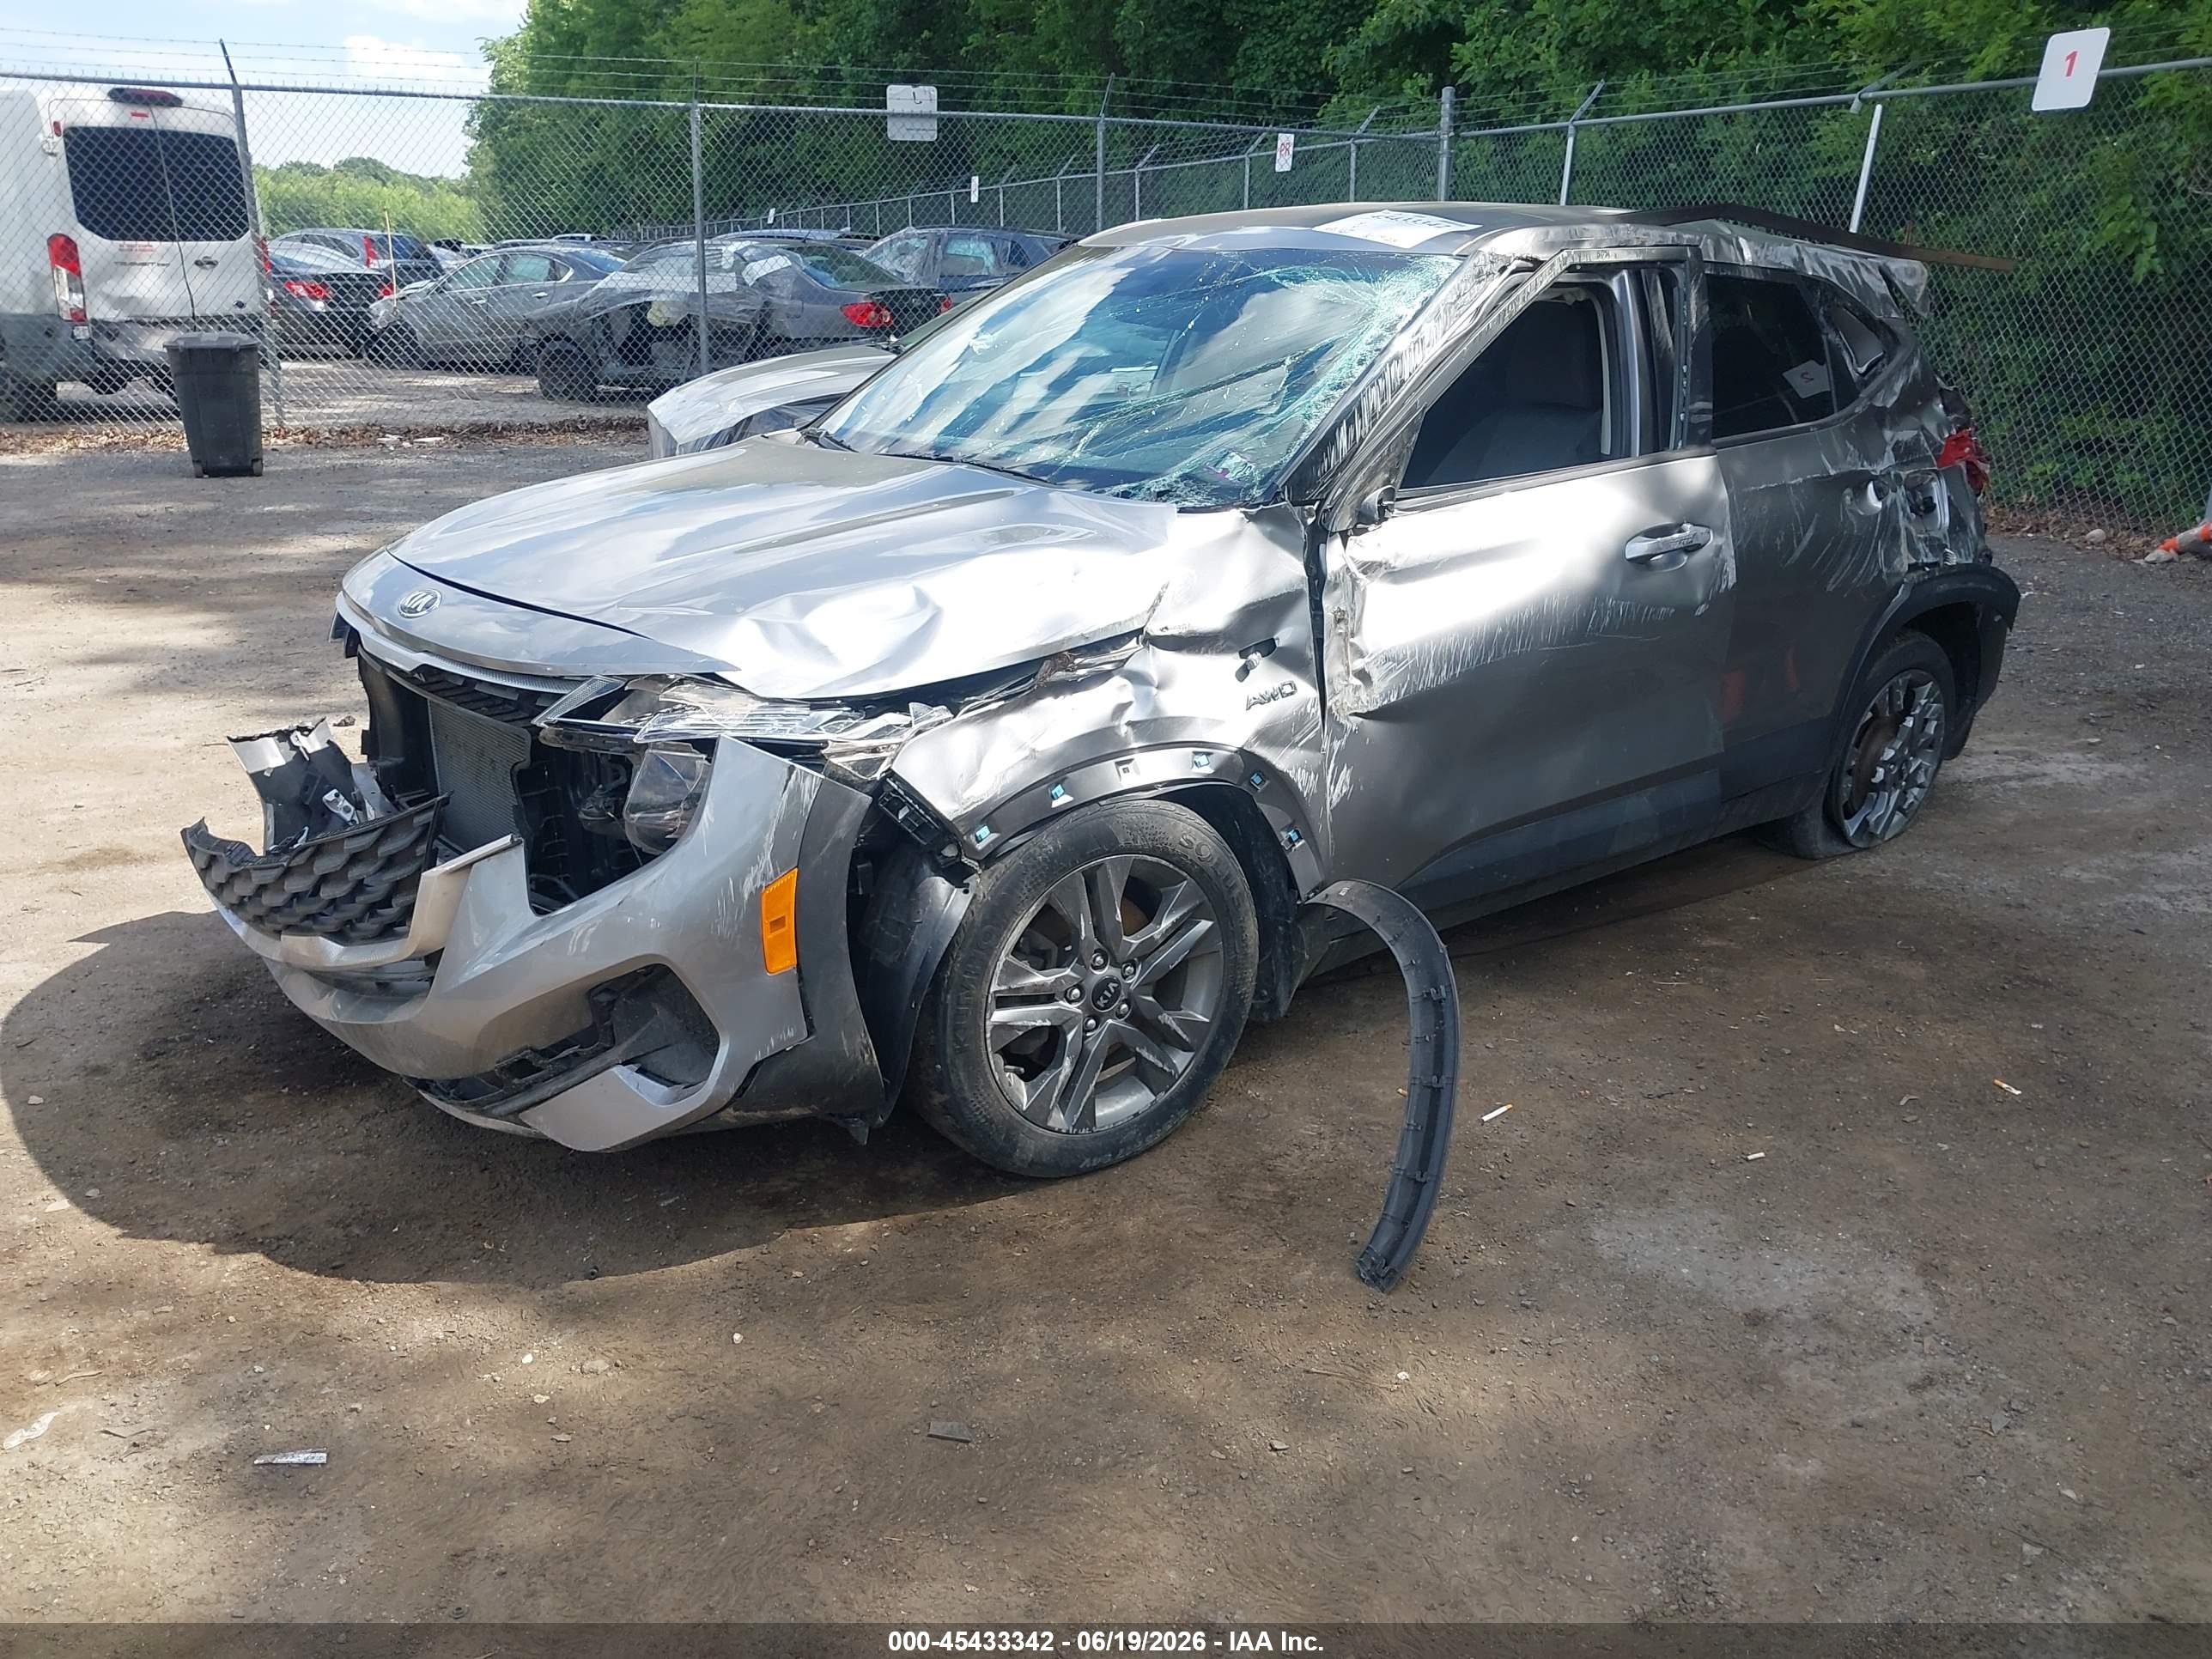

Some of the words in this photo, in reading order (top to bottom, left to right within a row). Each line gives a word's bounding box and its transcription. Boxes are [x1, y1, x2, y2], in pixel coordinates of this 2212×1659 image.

[2065, 51, 2078, 77] 1
[1245, 681, 1297, 711] AWD
[1097, 982, 1119, 1007] KIA
